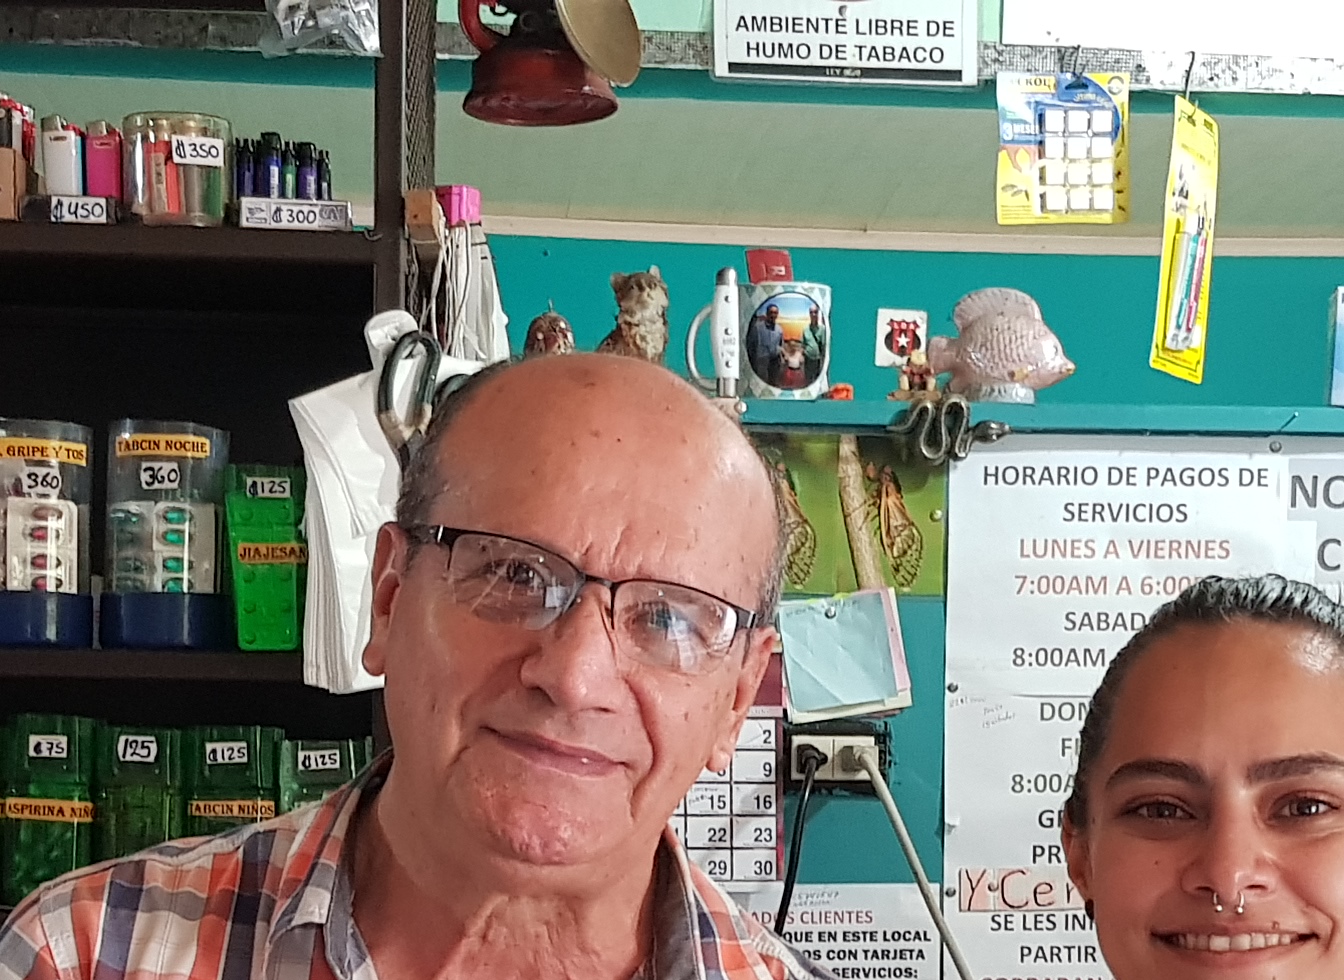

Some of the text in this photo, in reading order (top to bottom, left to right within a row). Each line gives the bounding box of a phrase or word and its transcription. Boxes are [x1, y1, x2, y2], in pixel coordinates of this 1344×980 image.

[735, 16, 955, 37] AMBIENTE LIBRE DE
[746, 42, 945, 63] HUMO DE TABACO
[6, 446, 48, 459] GRIPE
[50, 446, 63, 458] Y
[64, 448, 86, 461] TOS
[117, 439, 207, 453] TABCIN NOCHE
[26, 473, 61, 491] 360
[143, 465, 179, 487] 360
[982, 465, 1269, 488] HORARIO DE PAGOS DE
[1062, 502, 1189, 523] SERVICIOS
[1019, 538, 1232, 561] LUNES A VIERNES
[1014, 575, 1133, 596] 7:00AM A
[1063, 611, 1152, 632] SABAD
[1012, 647, 1107, 668] 8:00AM
[762, 729, 772, 744] 2
[121, 740, 152, 760] 125
[762, 762, 773, 777] 9
[236, 801, 274, 817] NIÑOS
[709, 794, 727, 810] 15
[754, 794, 773, 810] 16
[707, 827, 727, 843] 22
[753, 827, 773, 843] 23
[708, 860, 727, 876] 29
[753, 860, 773, 876] 30
[965, 868, 987, 911] Y
[800, 911, 874, 925] CLIENTES
[990, 914, 1057, 931] SE LES
[782, 930, 932, 943] QUE EN ESTE LOCAL
[826, 949, 926, 961] CON TARJETA
[1019, 946, 1098, 963] PARTIR
[832, 967, 918, 979] SERVICIOS:
